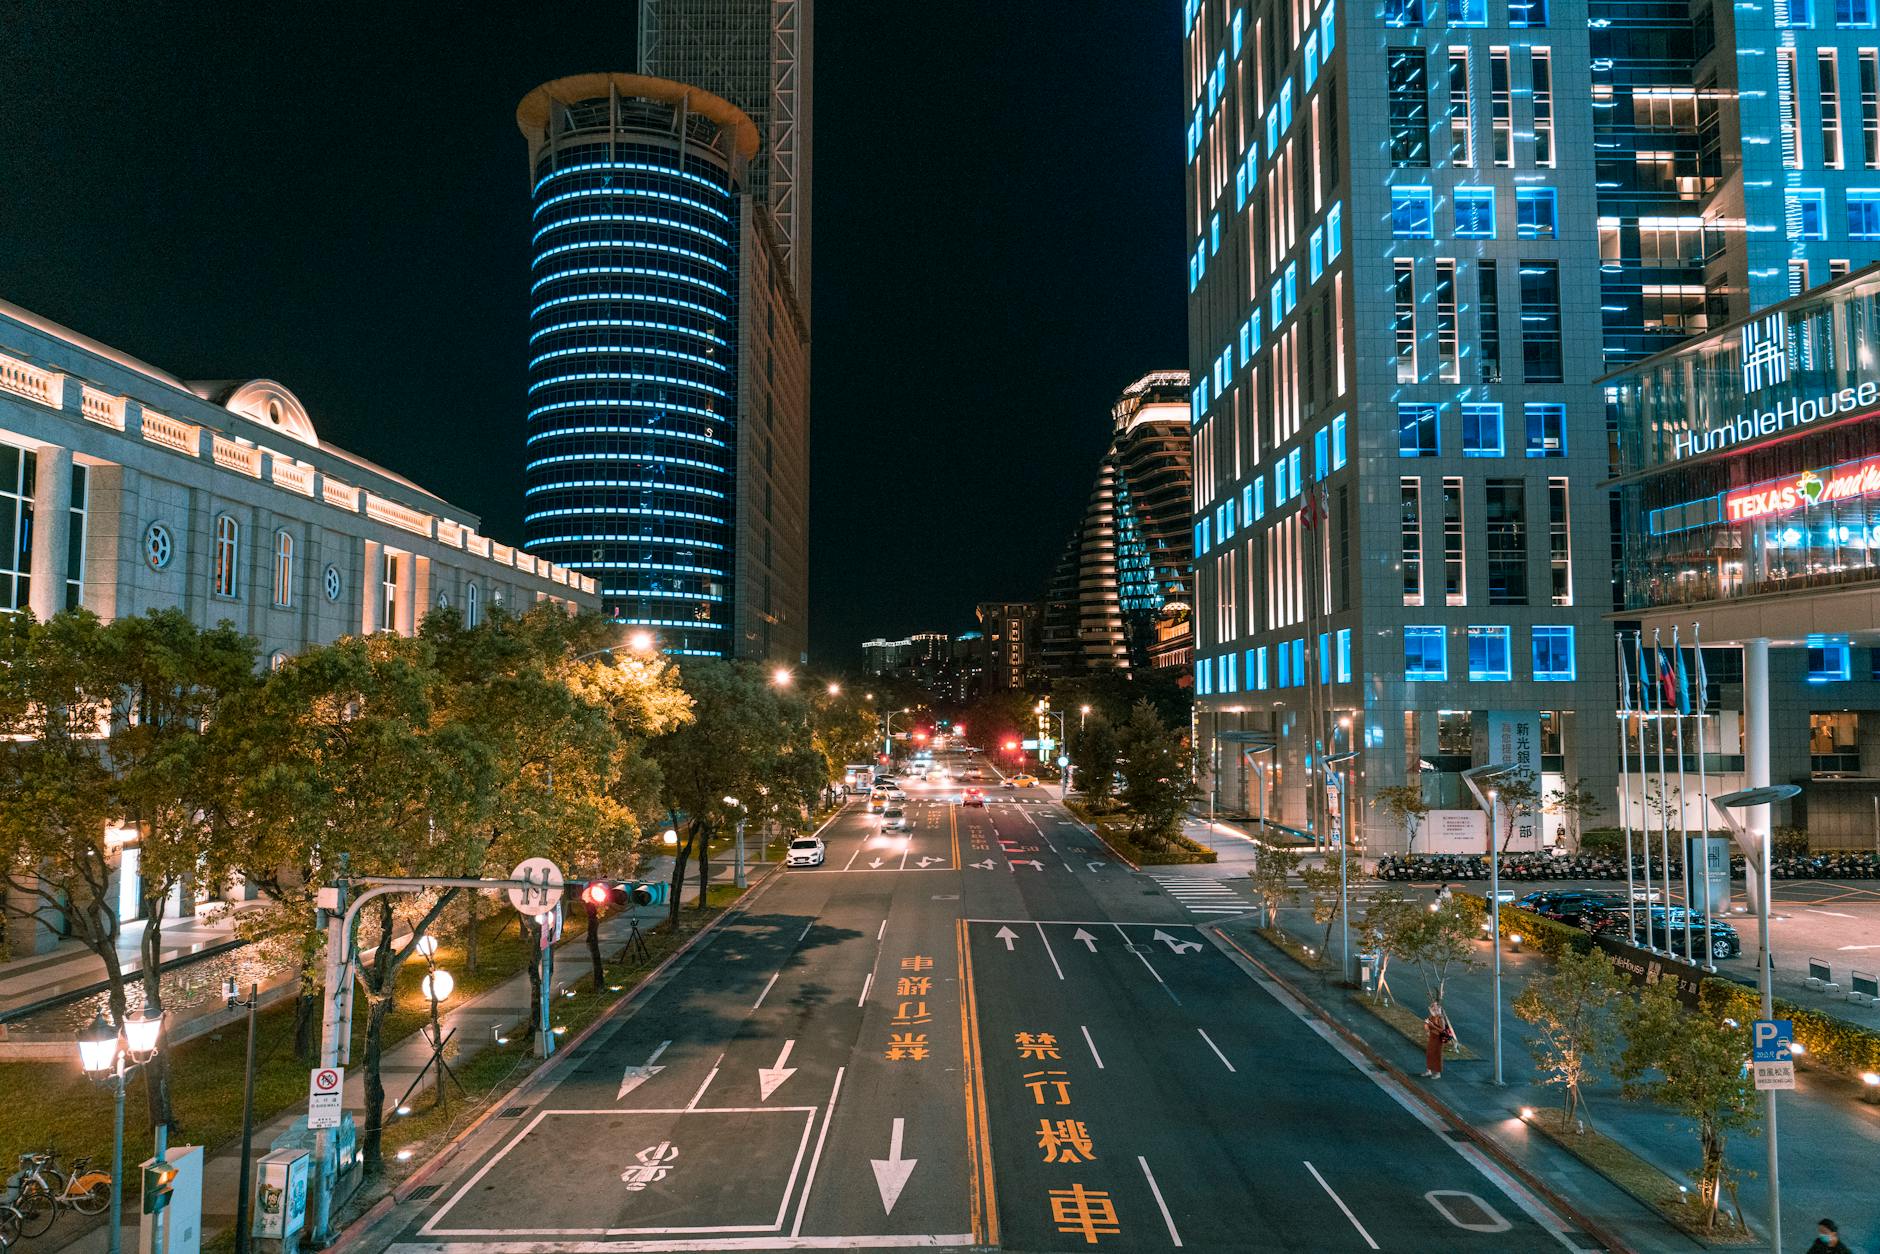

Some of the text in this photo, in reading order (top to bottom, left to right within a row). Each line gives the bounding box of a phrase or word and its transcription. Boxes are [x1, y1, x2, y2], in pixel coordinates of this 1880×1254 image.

[1675, 381, 1877, 460] HumbleHouse
[1728, 486, 1796, 521] TEXAS
[1516, 722, 1531, 778] 新光銀行
[1611, 954, 1645, 976] bleHouse
[885, 954, 935, 1062] 禁行機車
[1755, 1022, 1778, 1049] P
[1014, 1031, 1122, 1244] 禁行機車
